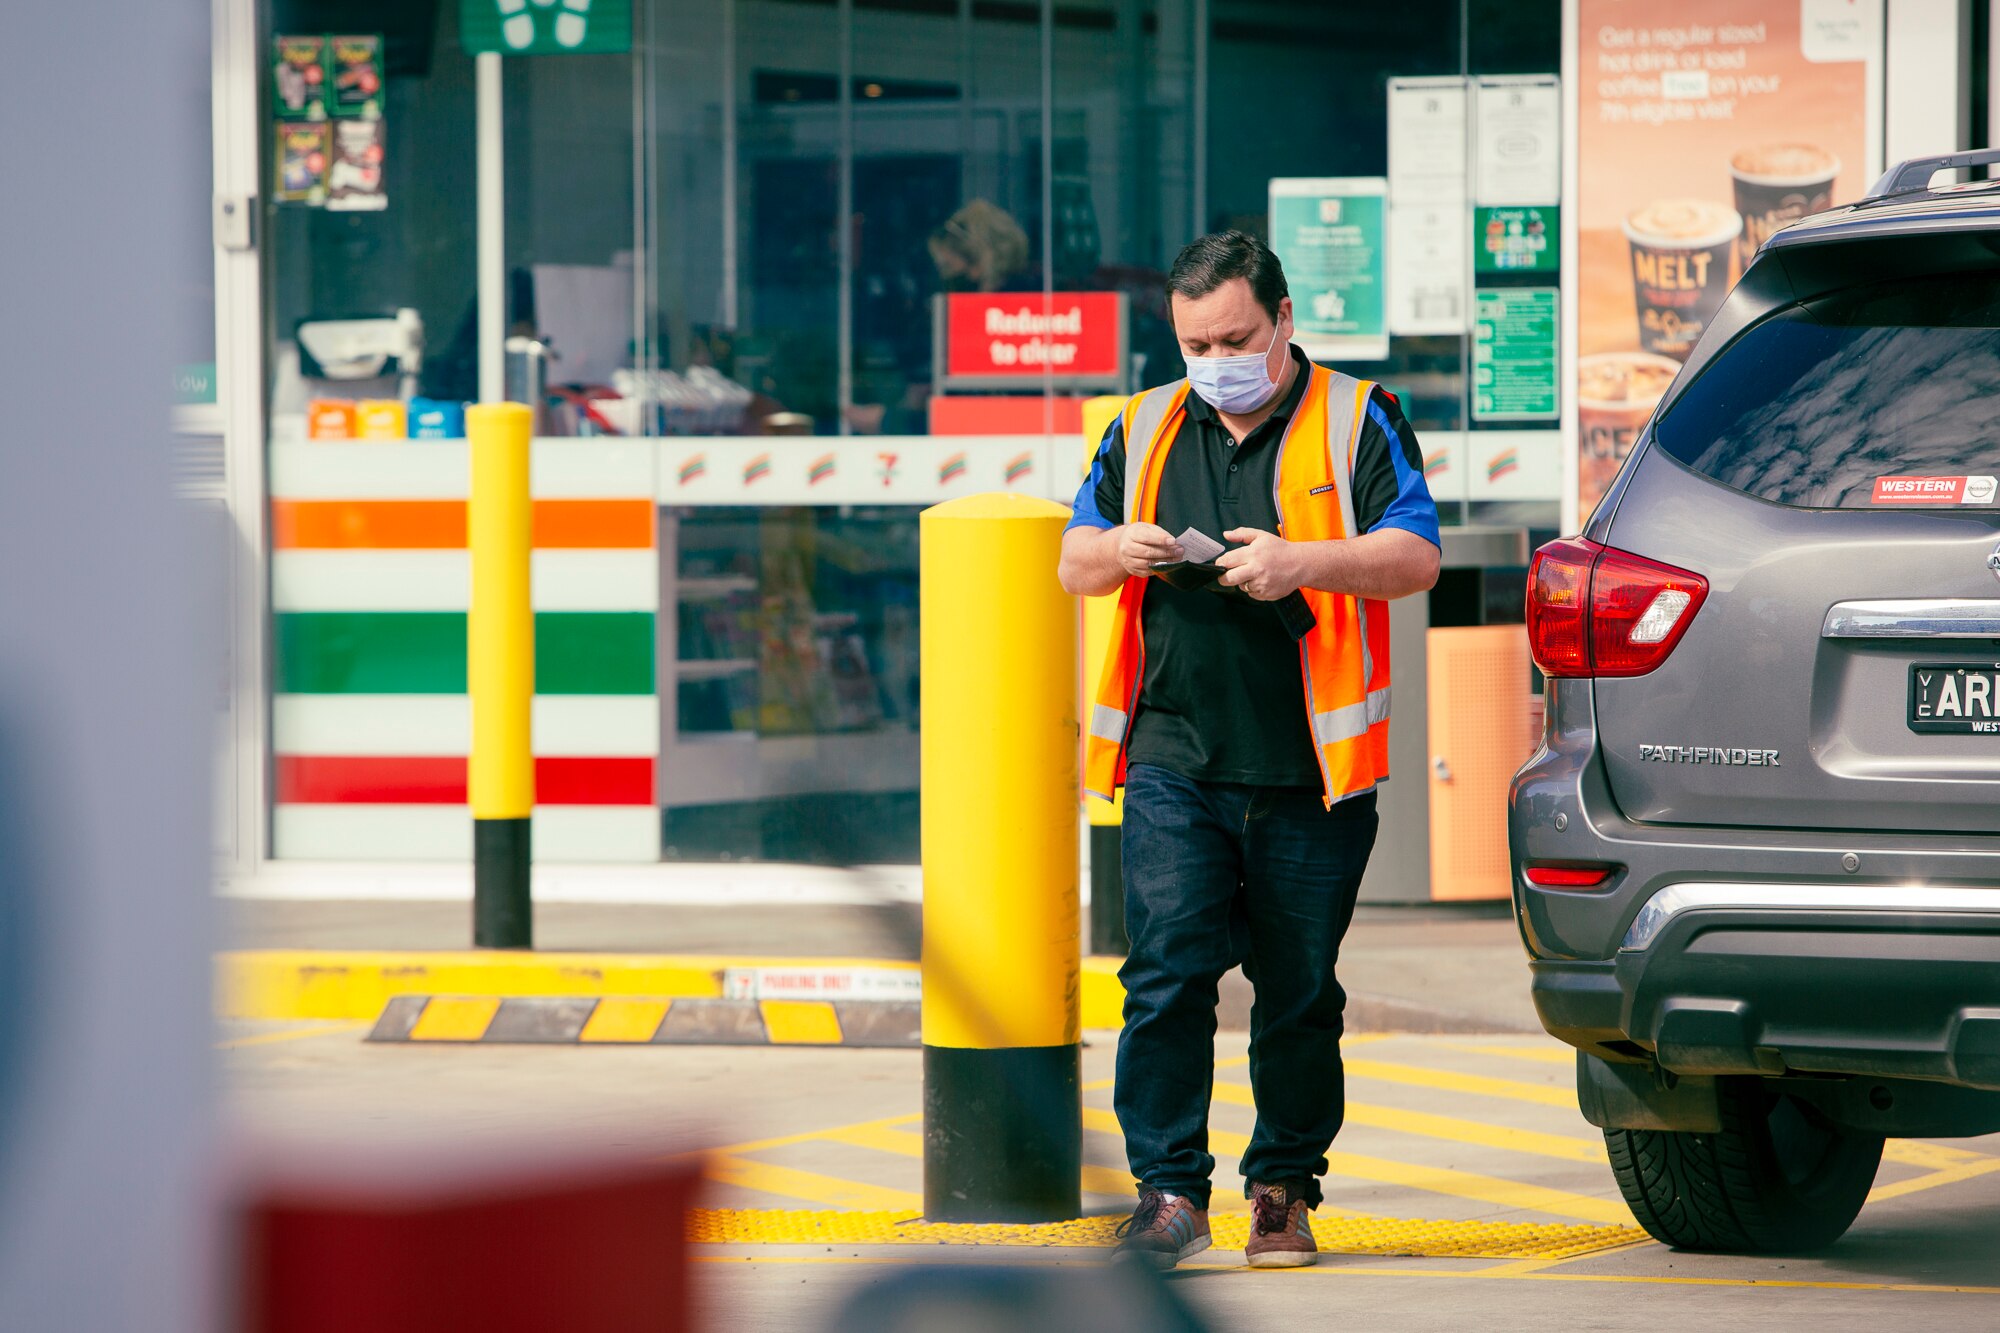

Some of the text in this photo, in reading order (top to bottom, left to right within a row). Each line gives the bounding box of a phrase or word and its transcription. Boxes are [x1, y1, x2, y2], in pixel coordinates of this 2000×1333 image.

[1599, 26, 1634, 47] Get
[1652, 23, 1713, 50] regular
[1717, 21, 1766, 44] sized
[1599, 51, 1630, 72] hot
[1632, 50, 1677, 71] drink
[1680, 52, 1699, 69] or
[1598, 75, 1659, 97] coffee
[1711, 76, 1737, 94] on
[1738, 74, 1780, 97] your
[1635, 250, 1712, 290] MELT
[985, 305, 1082, 335] Reduced
[990, 336, 1077, 366] to clear
[1881, 480, 1957, 492] WESTERN
[1639, 744, 1780, 766] PATHFINDER
